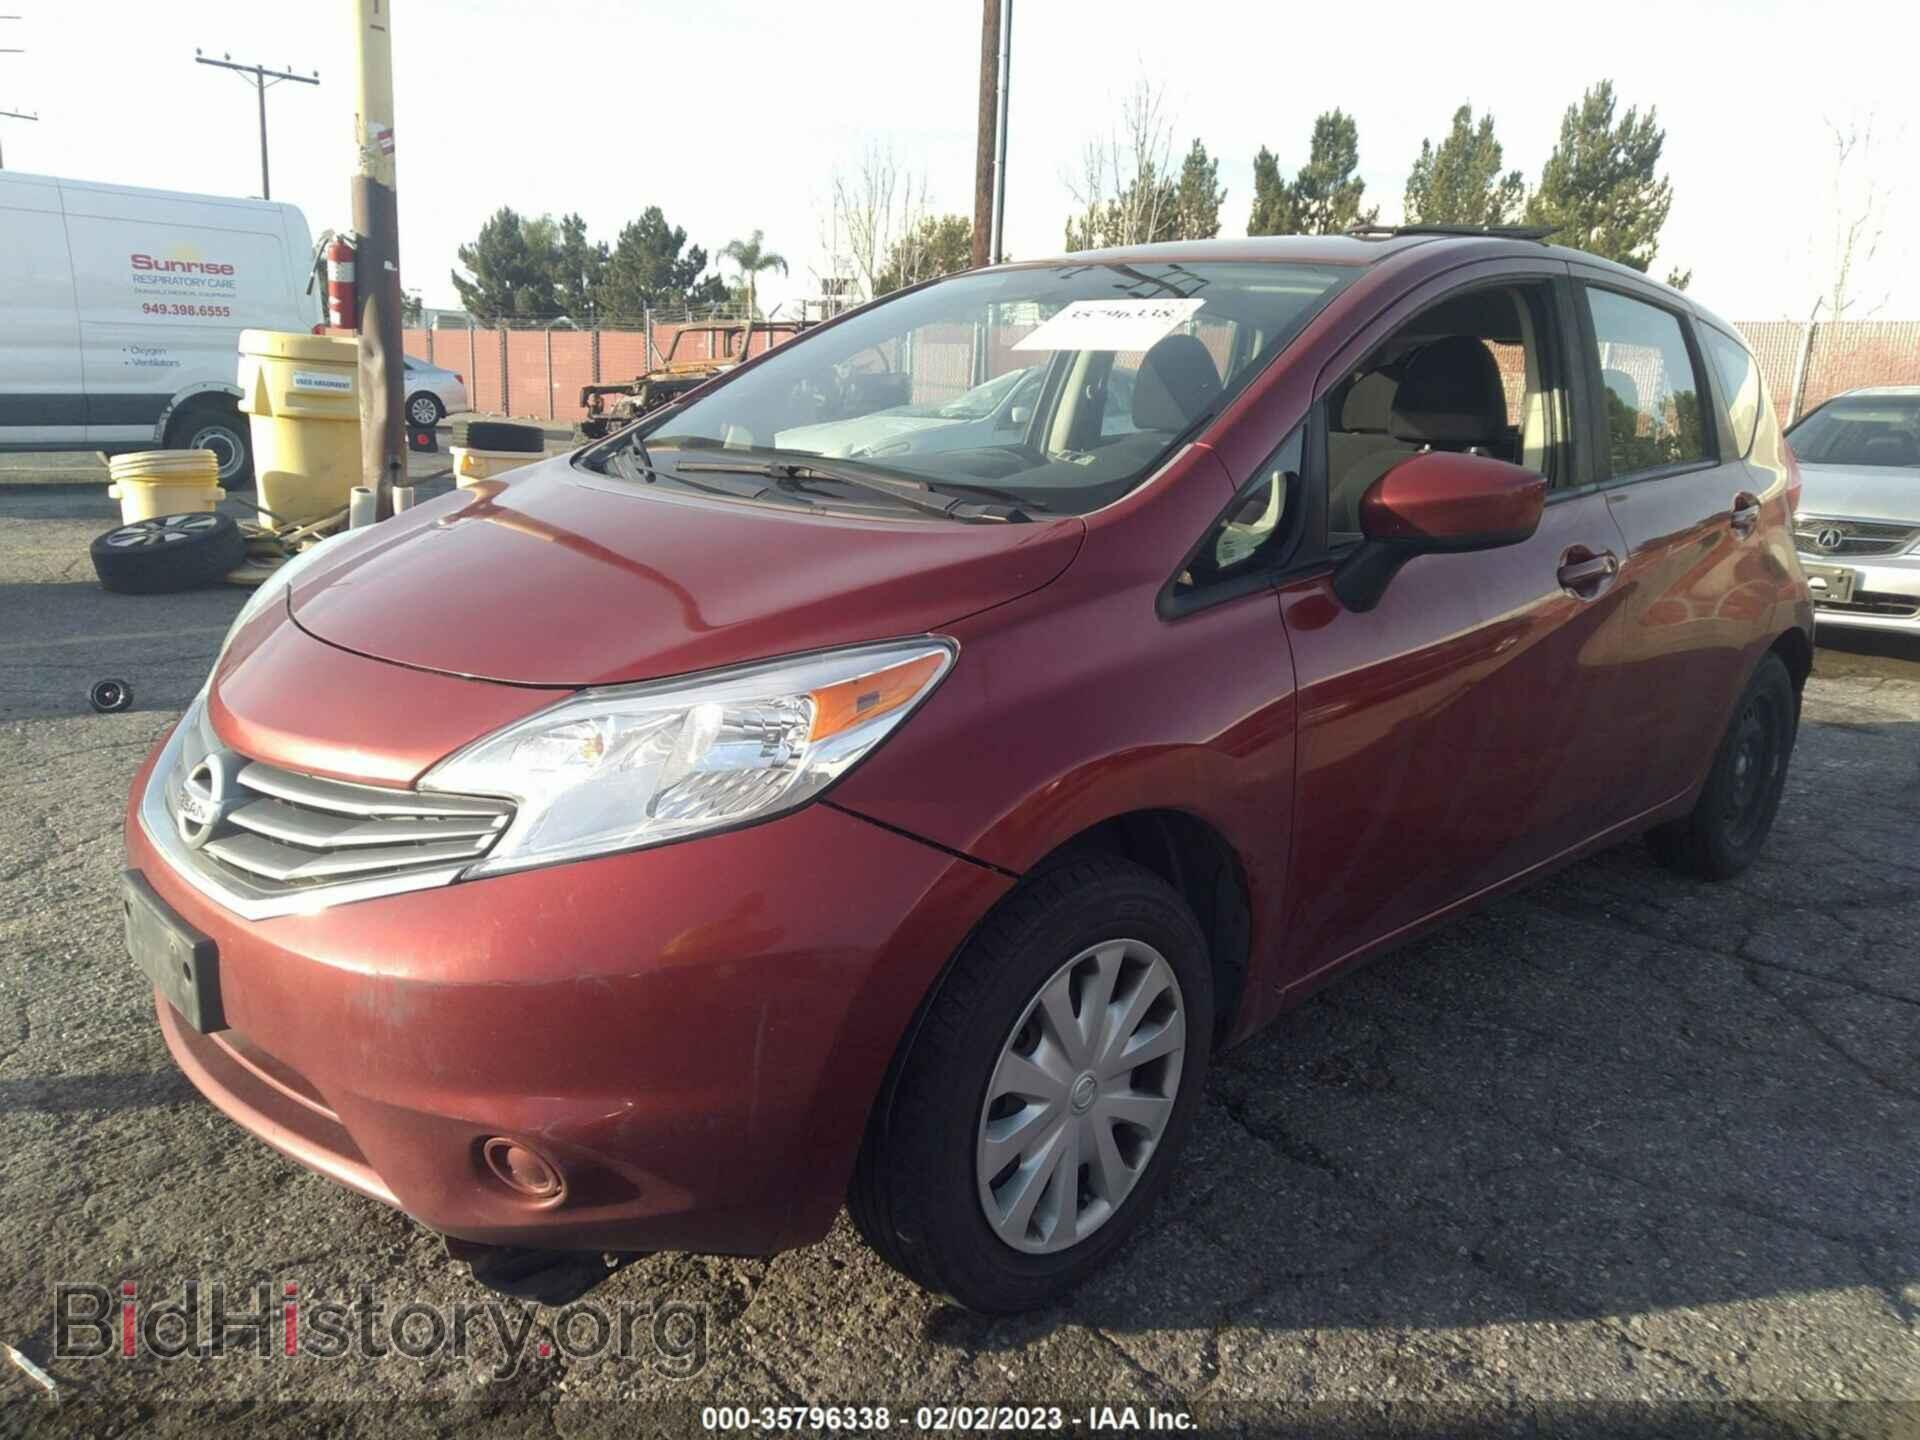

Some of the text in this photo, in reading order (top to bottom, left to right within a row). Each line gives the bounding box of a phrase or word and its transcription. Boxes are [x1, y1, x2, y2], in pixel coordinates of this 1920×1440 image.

[131, 253, 234, 276] Sunrise
[132, 274, 236, 289] RESPIRATORY CARE
[142, 302, 231, 318] 949.398.6555
